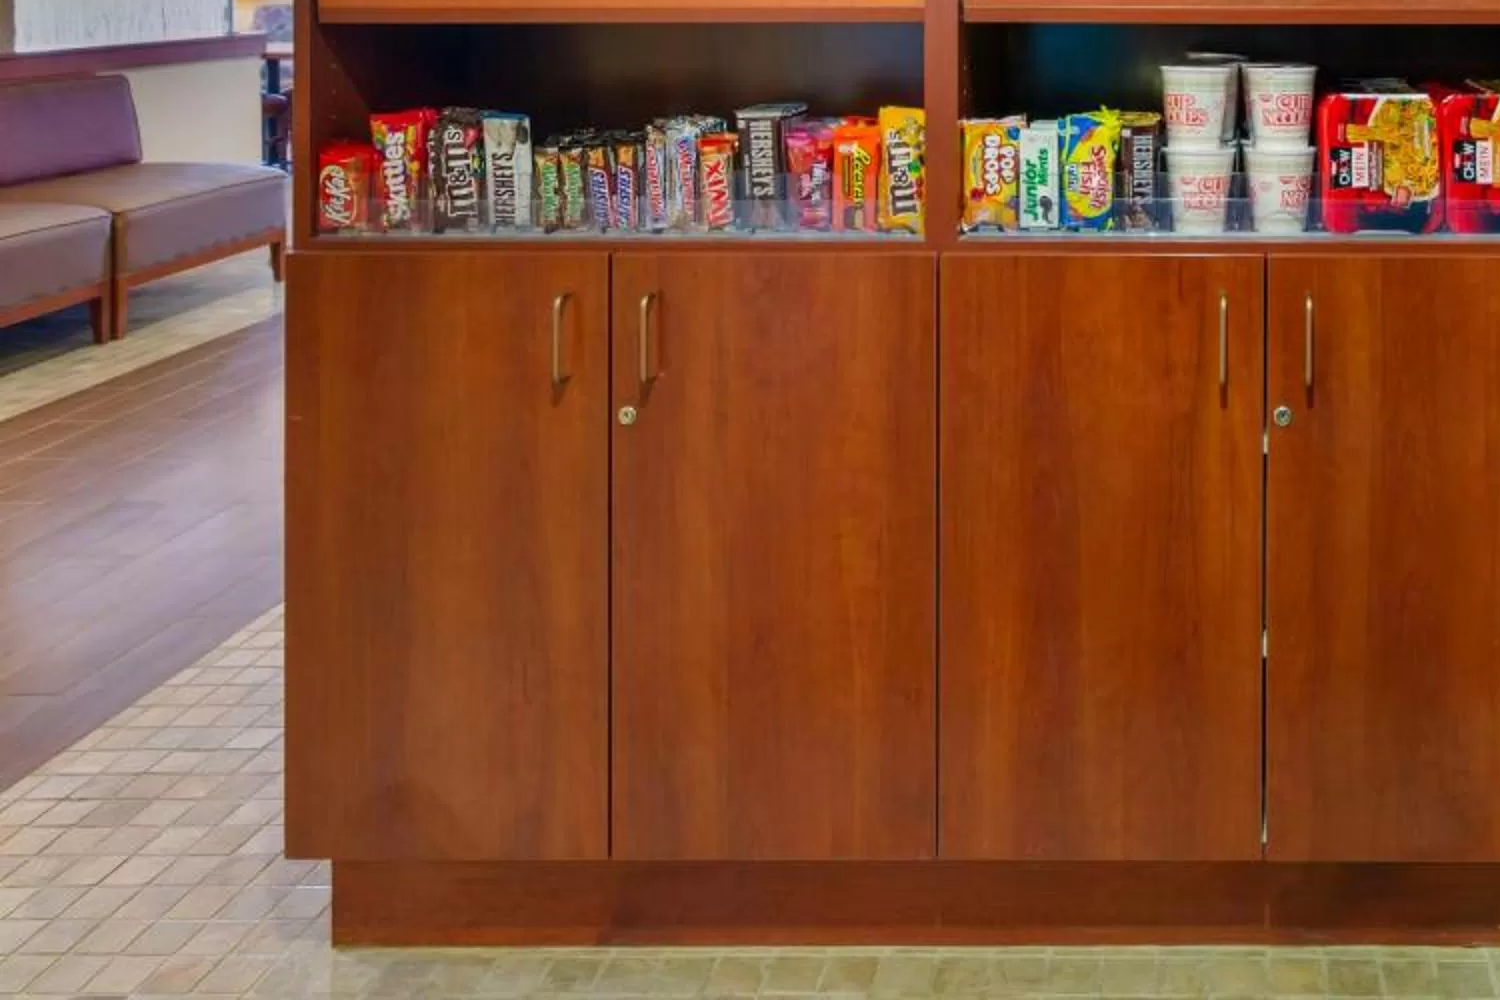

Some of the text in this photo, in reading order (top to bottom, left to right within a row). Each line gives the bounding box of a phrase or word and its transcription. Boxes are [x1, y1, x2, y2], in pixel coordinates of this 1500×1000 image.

[750, 120, 774, 196] HERSHEY'S
[1037, 148, 1049, 187] Mints
[1080, 160, 1095, 196] Fish
[1090, 145, 1109, 209] Swedish
[1355, 149, 1366, 182] MEIN
[1480, 145, 1490, 180] MEIN
[490, 151, 516, 226] HERSHEY'S
[1023, 159, 1039, 221] Junior
